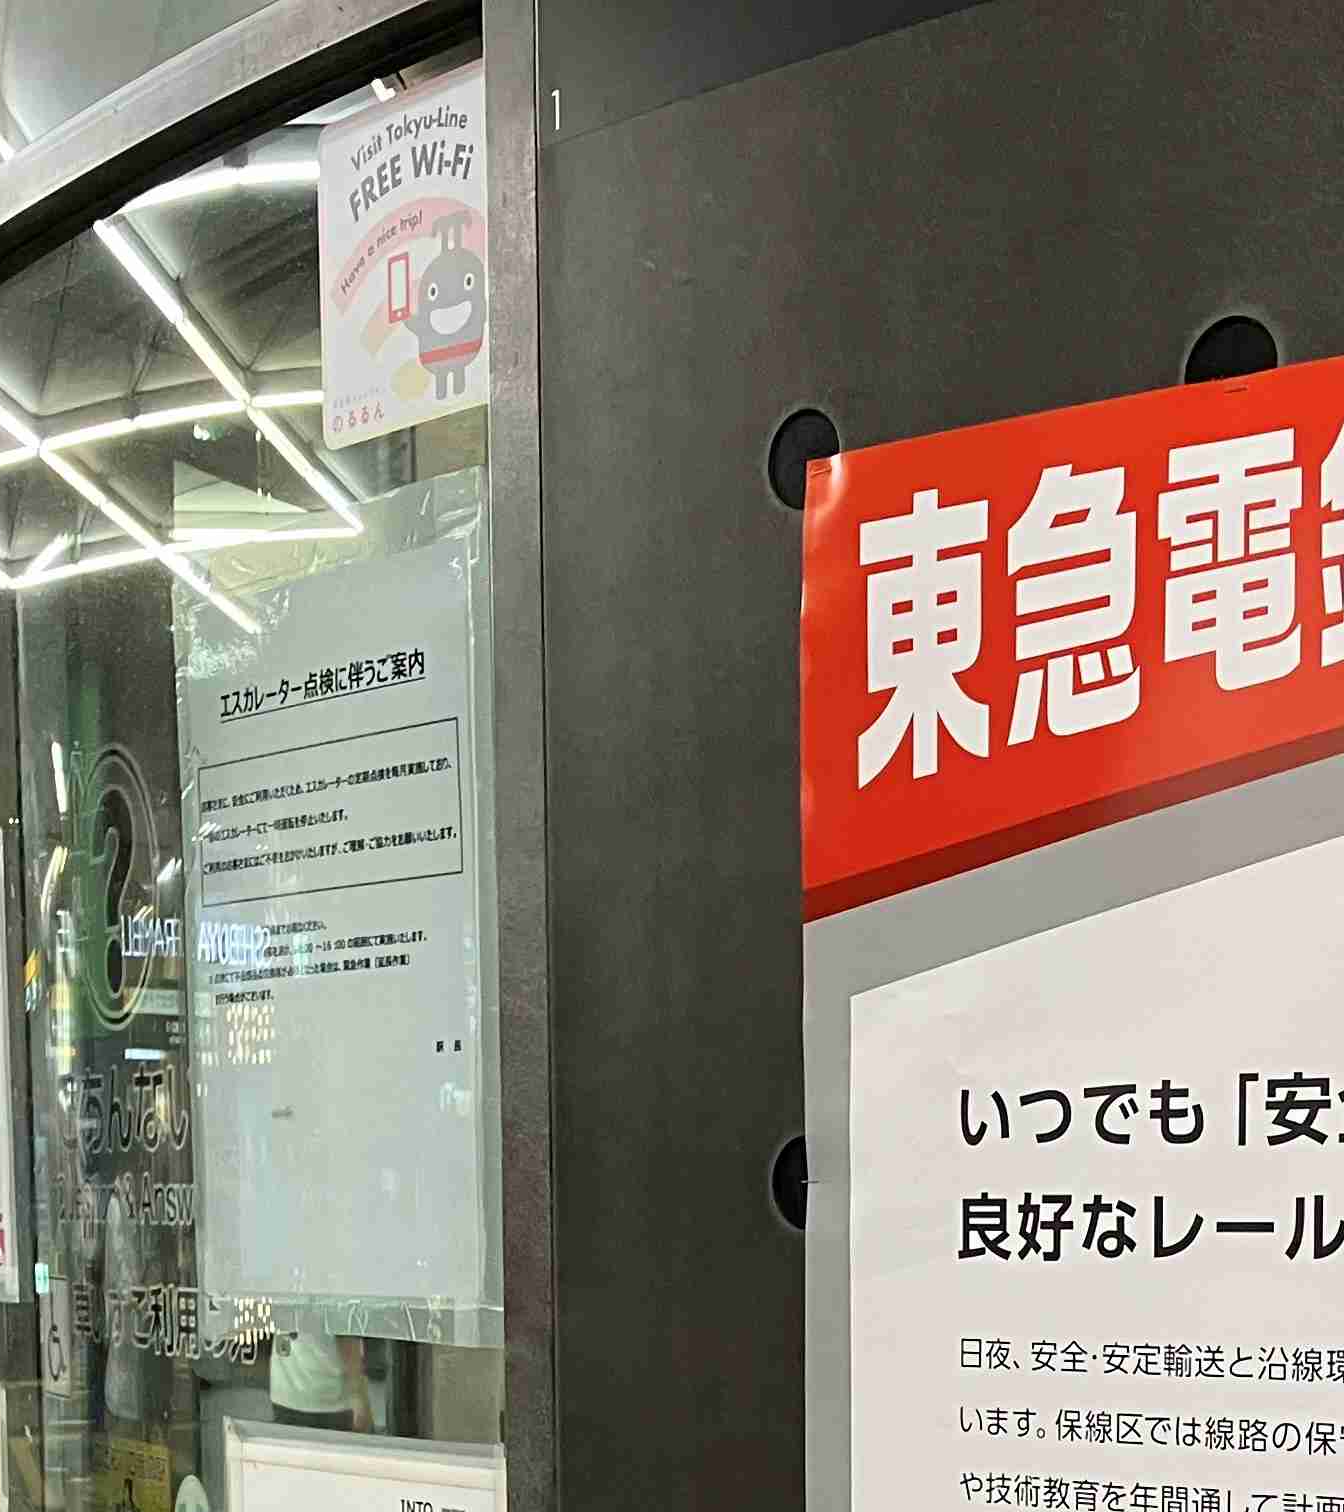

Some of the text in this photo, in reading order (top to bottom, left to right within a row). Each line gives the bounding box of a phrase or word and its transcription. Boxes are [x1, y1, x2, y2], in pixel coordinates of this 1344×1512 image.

[351, 105, 468, 172] Visit Tokyu-Line
[348, 140, 474, 223] FREE Wi-Fi
[340, 257, 365, 296] Have
[376, 226, 398, 248] nice
[399, 207, 424, 234] trip!
[220, 648, 425, 718] エスカレーター点検に伴うご案内
